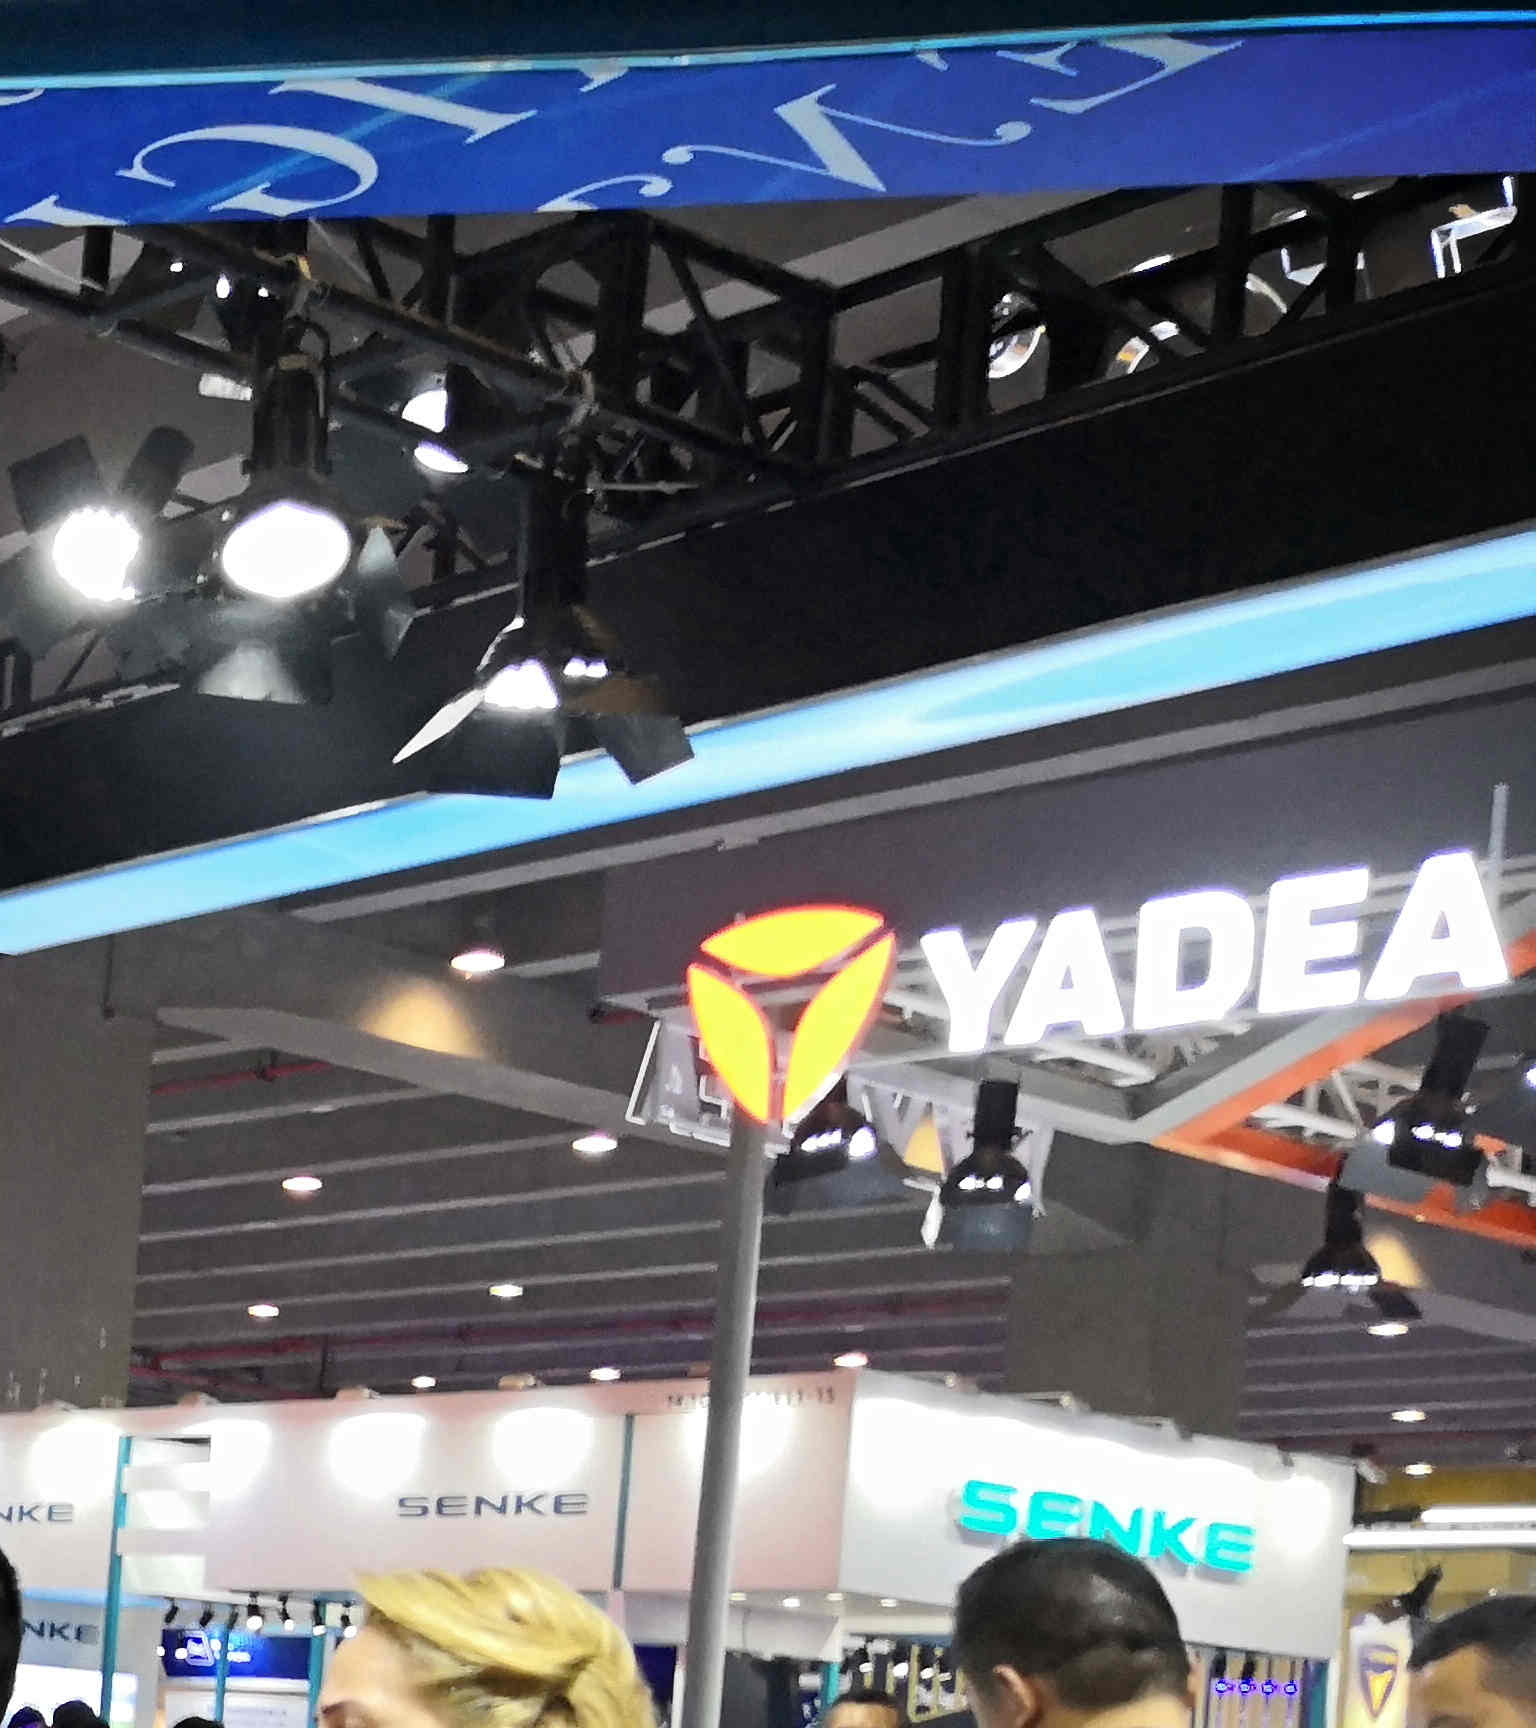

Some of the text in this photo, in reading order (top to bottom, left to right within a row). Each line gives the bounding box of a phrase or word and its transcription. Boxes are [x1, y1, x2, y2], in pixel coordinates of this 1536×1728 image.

[920, 849, 1510, 1052] YADEA
[396, 1490, 591, 1518] SENKE
[958, 1479, 1258, 1577] SENKE
